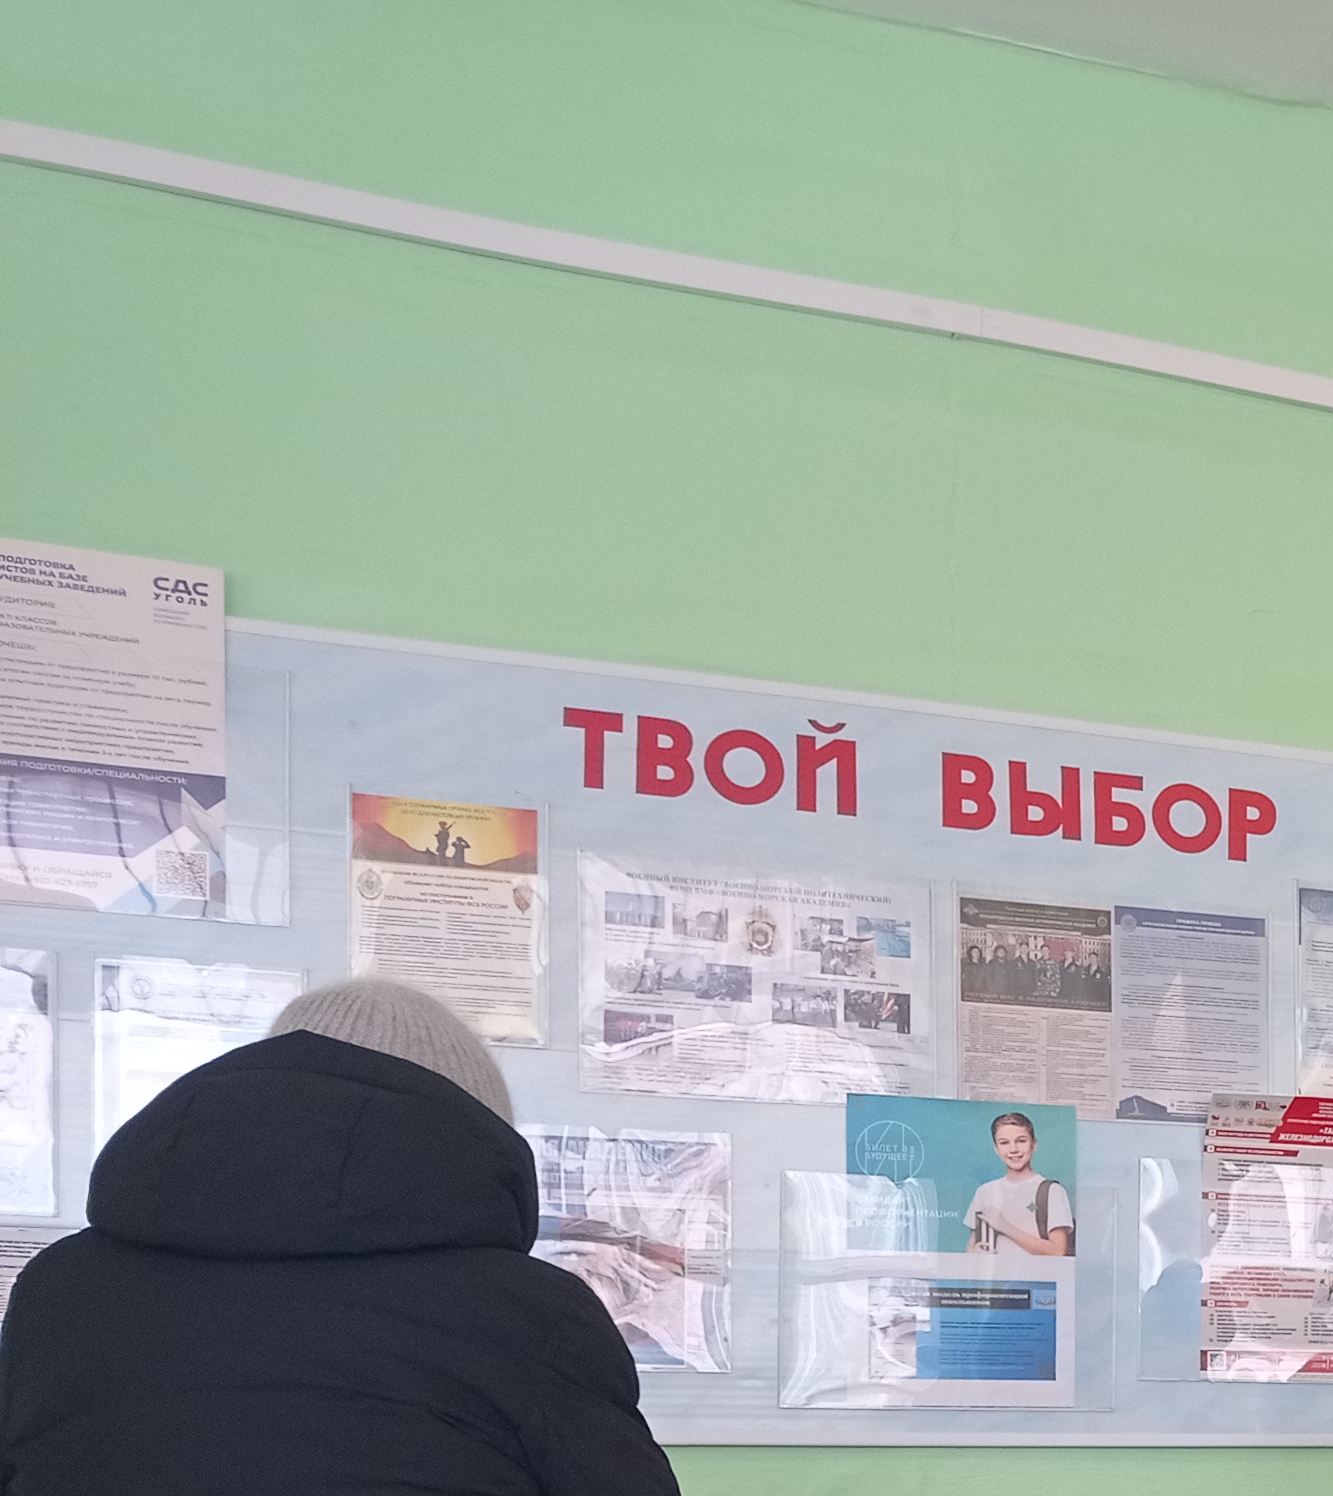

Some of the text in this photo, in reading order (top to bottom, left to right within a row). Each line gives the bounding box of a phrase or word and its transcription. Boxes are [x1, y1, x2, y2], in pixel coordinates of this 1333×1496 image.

[0, 564, 89, 582] ИСТОВ НА БАЗЕ
[57, 581, 127, 597] ЗАВЕДЕНИЙ
[153, 576, 209, 597] СДС
[0, 596, 57, 608] УДИТОРИЯ:
[153, 592, 208, 607] УГОЛЬ
[0, 622, 76, 636] РАЗОВАТЕЛЬНЫХ
[563, 707, 1277, 862] ТВОЙ ВЫБОР
[865, 1144, 898, 1152] БИЛЕТ
[865, 1152, 908, 1161] БУДУЩЕЕ
